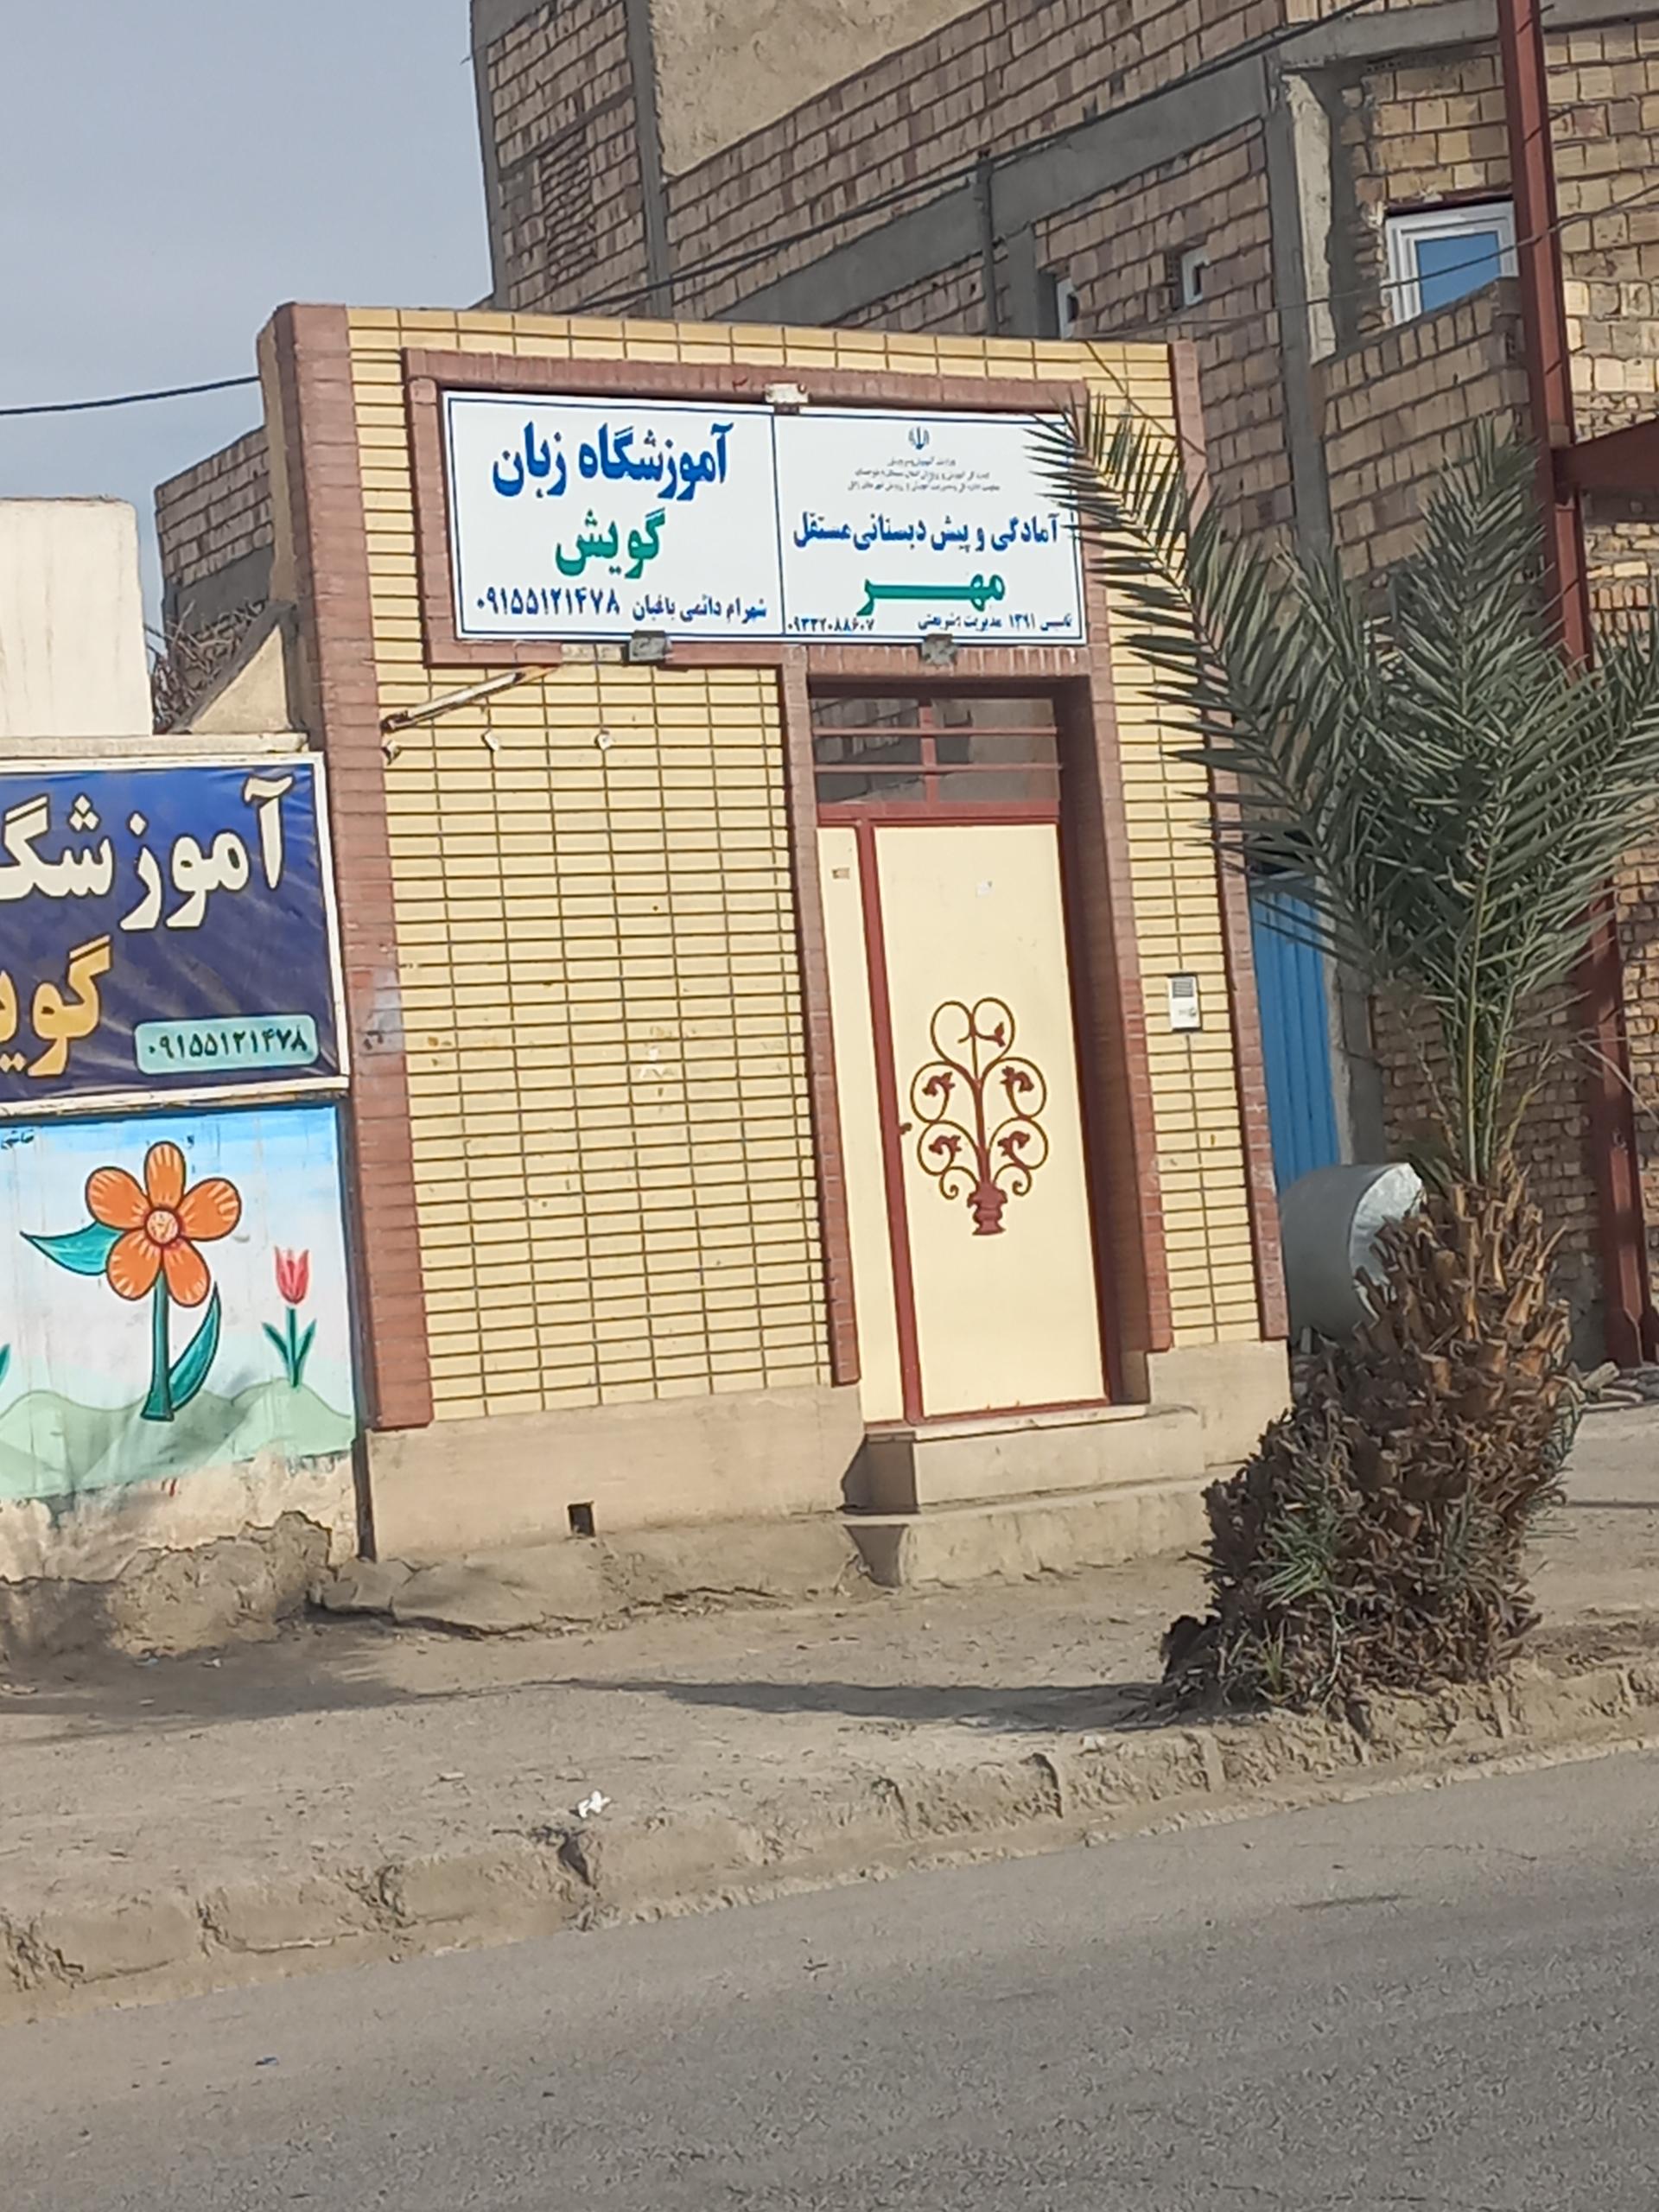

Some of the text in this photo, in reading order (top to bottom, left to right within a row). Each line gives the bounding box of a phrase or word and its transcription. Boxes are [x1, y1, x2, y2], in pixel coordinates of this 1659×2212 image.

[492, 420, 734, 501] آموزشگاه زبان
[555, 507, 666, 579] گویش
[793, 511, 1060, 553] آمادگی و پیش دبستانی مستقل
[476, 586, 621, 616] ۰۹۱۵۵۱۲۱۴۷۸
[856, 572, 1006, 616] مهر
[0, 774, 295, 931] آموزشگ
[0, 934, 114, 1077] گوی
[149, 1025, 308, 1059] ۰۹۱۵۵۱۲۱۴۷۸
